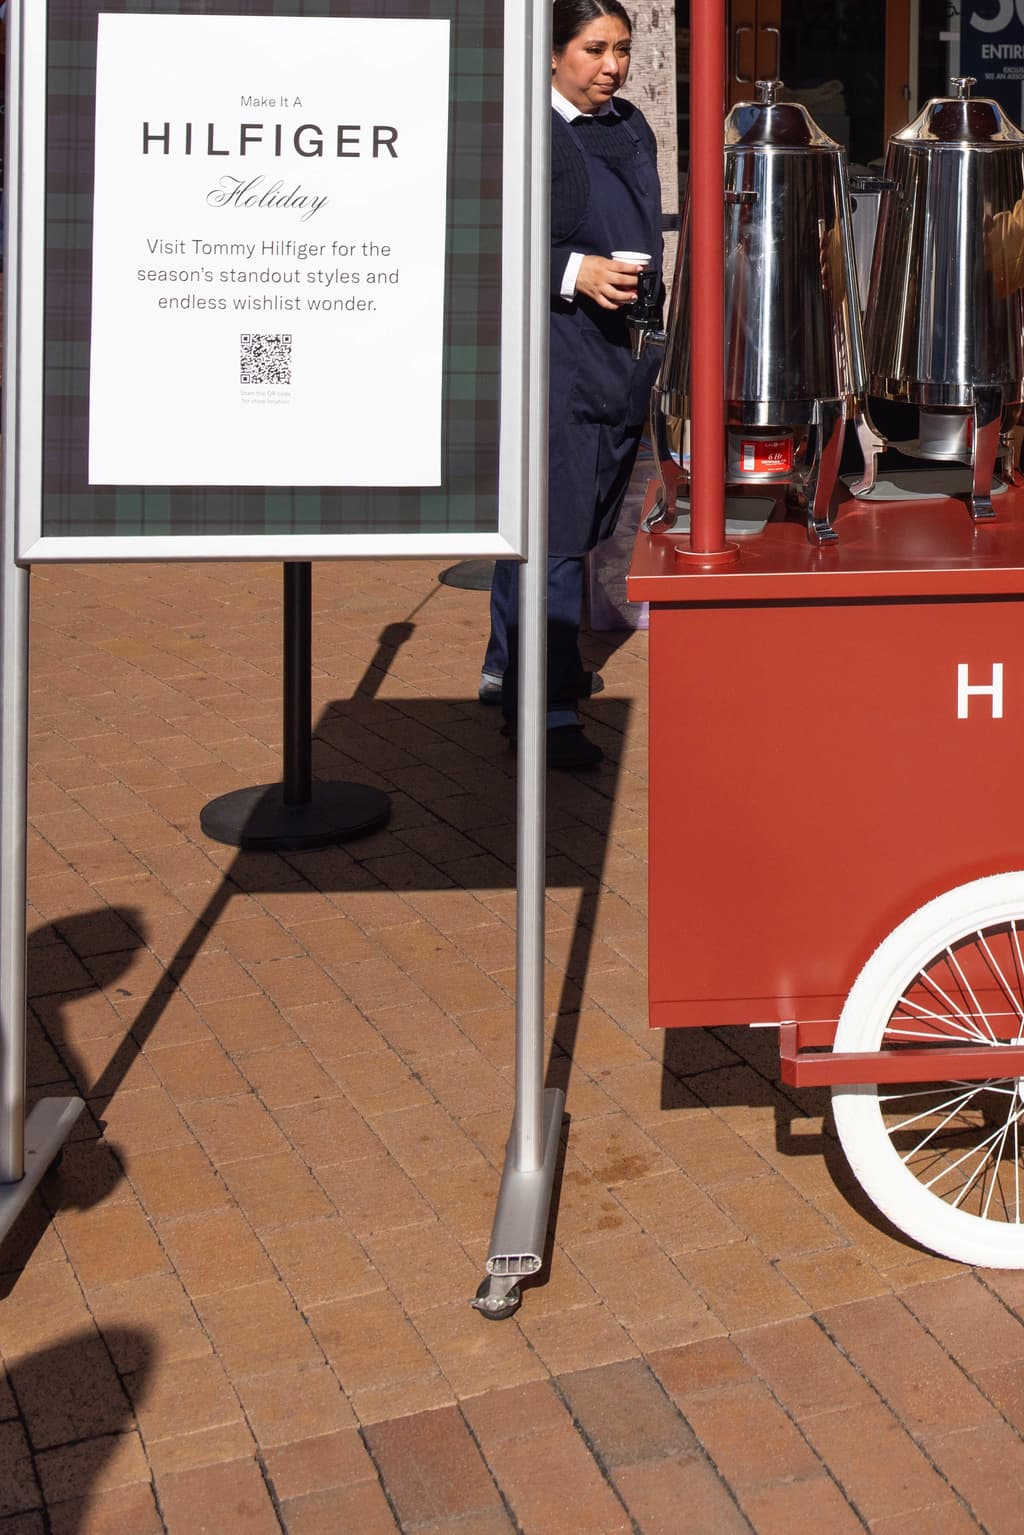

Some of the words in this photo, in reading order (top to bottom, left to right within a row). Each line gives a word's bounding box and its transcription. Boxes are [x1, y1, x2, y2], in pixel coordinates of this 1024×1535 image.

[240, 95, 276, 108] Make
[280, 96, 289, 108] It
[292, 96, 303, 108] A
[142, 121, 399, 159] HILFIGER
[205, 174, 329, 223] Holiday
[147, 238, 186, 255] Visit
[191, 239, 256, 259] Tommy
[261, 240, 326, 260] Hilfiger
[331, 240, 360, 257] for
[361, 241, 391, 257] the
[137, 267, 214, 283] season's
[219, 267, 301, 284] standout
[306, 268, 361, 288] styles
[366, 269, 399, 284] and
[157, 294, 227, 310] endless
[232, 294, 301, 311] wishlist
[307, 295, 378, 312] wonder.
